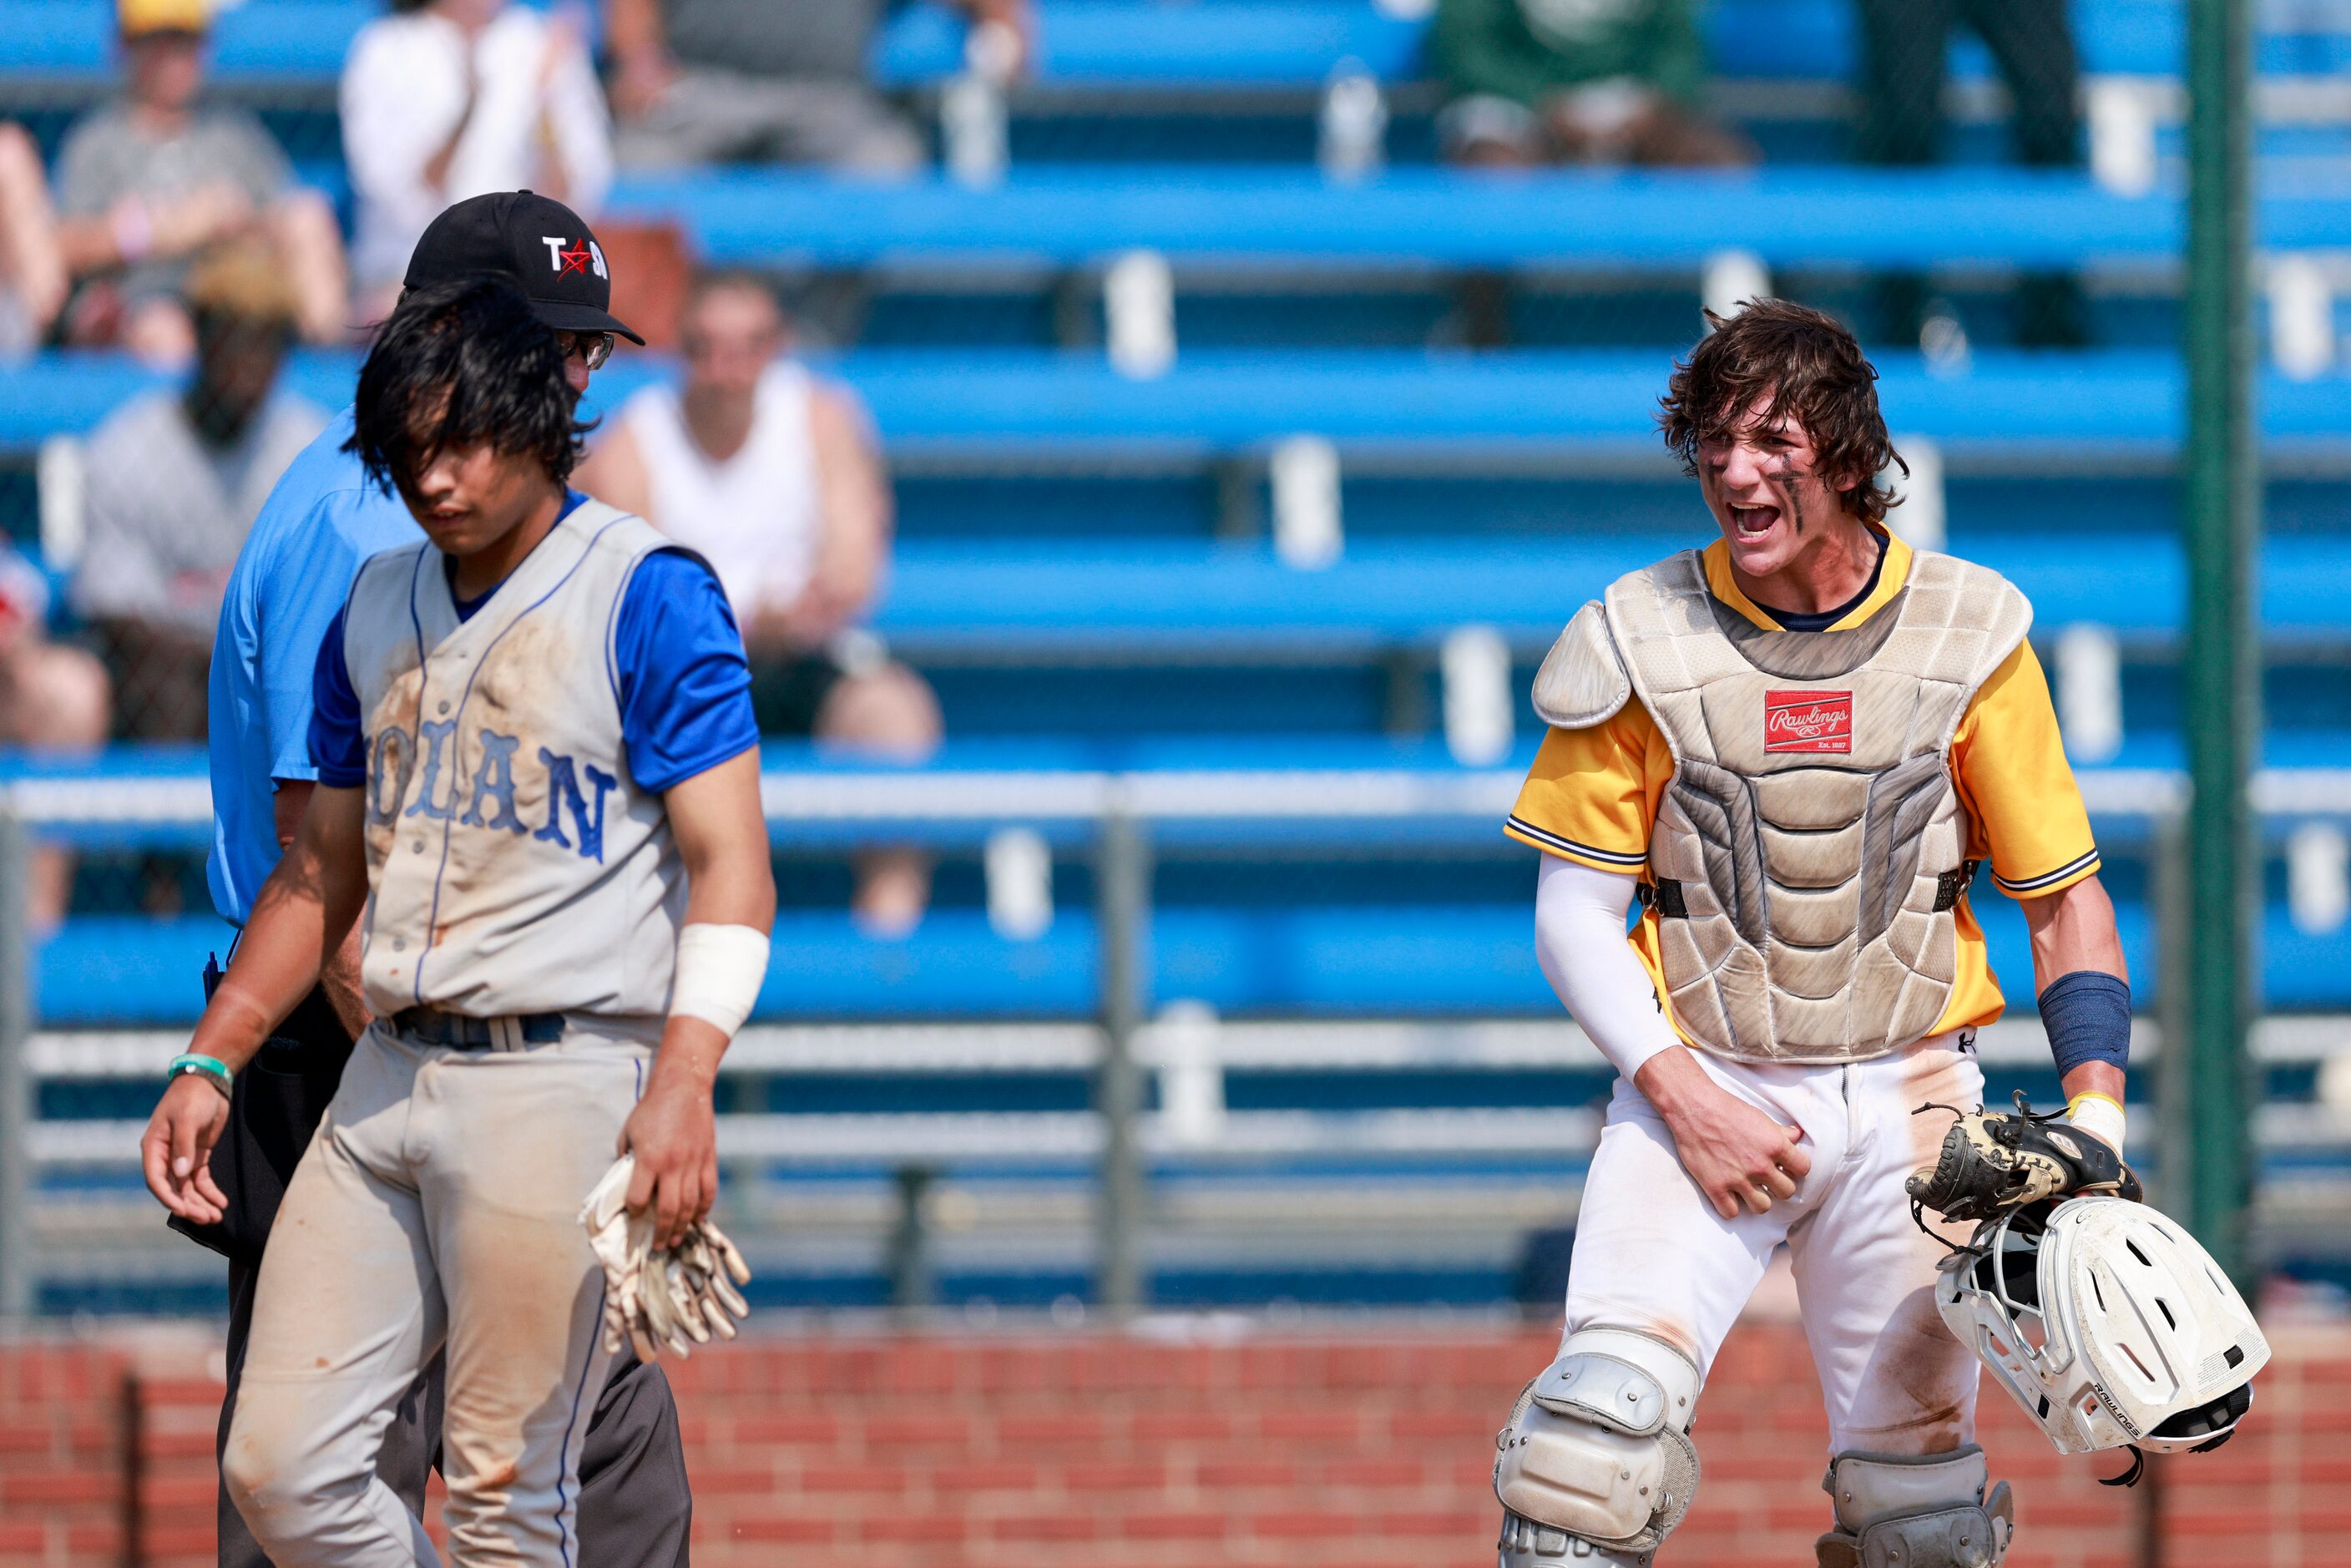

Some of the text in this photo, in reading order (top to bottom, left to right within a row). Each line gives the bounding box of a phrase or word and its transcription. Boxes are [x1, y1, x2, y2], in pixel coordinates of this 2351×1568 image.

[1770, 706, 1848, 732] Rawlings
[364, 719, 617, 865] OLAN
[2094, 1382, 2141, 1437] RAWLINGS
